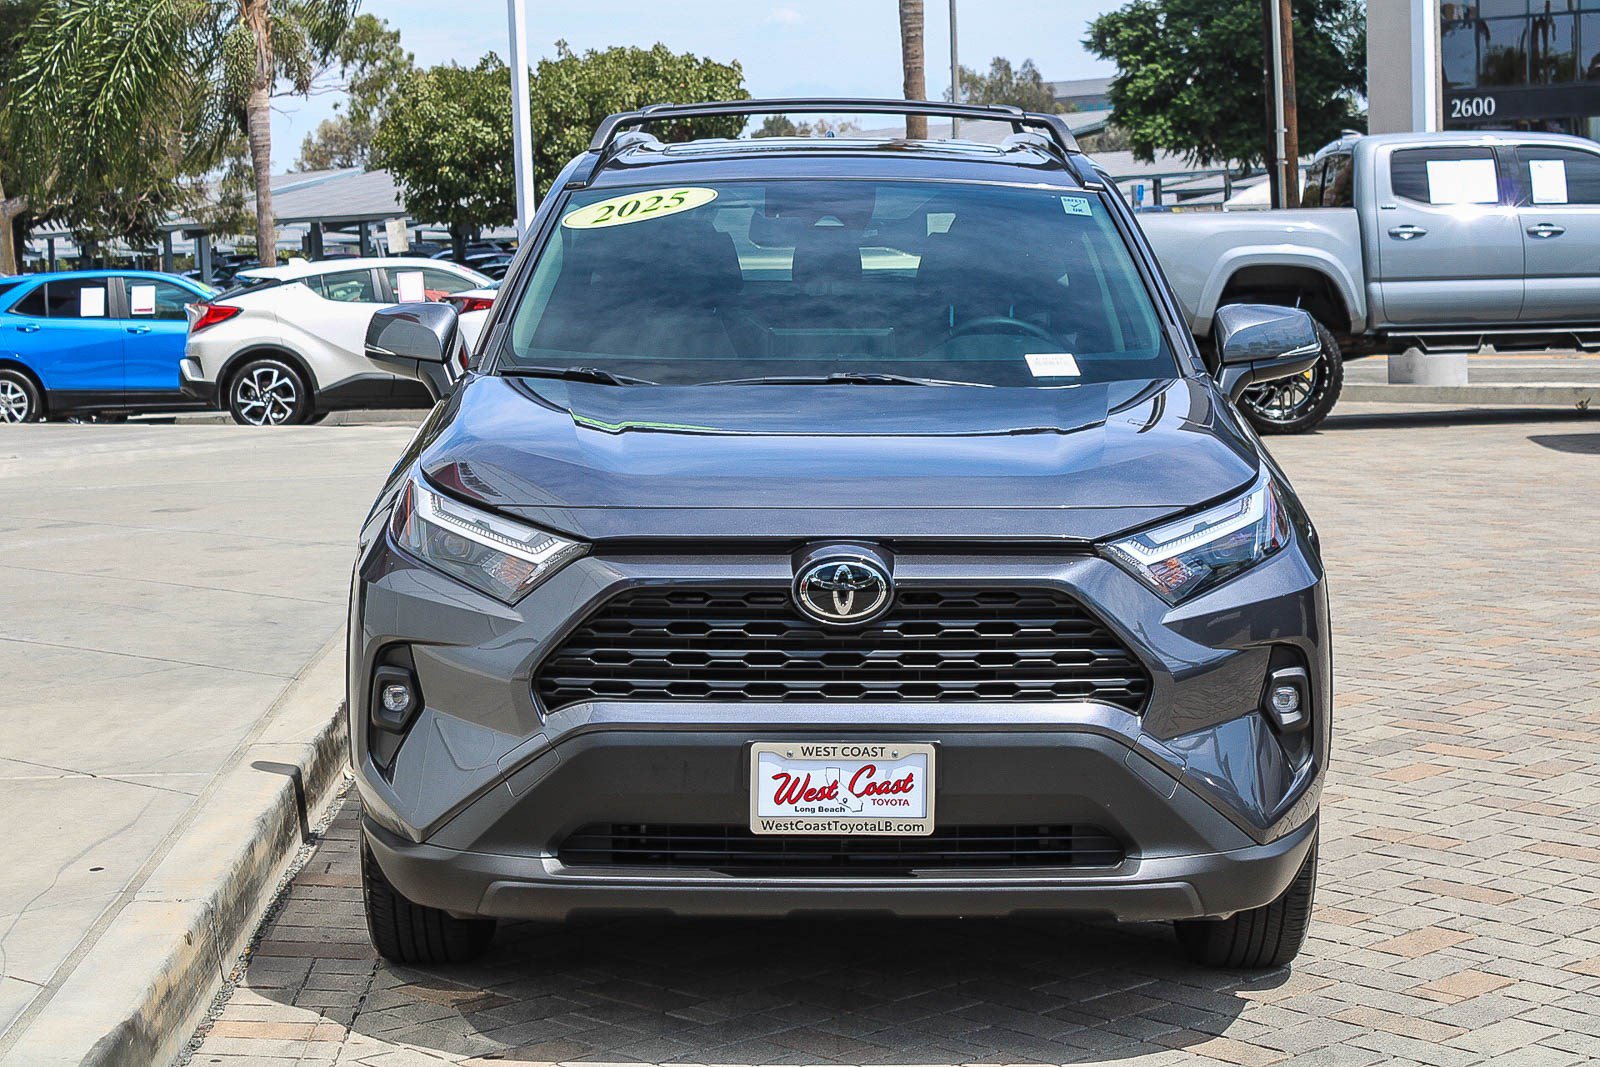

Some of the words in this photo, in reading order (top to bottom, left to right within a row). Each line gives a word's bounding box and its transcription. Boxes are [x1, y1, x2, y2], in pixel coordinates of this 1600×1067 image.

[1451, 96, 1496, 118] 2600
[591, 190, 690, 224] 2025
[801, 746, 838, 757] WEST
[841, 746, 886, 757] COAST
[771, 773, 839, 806] West
[848, 763, 914, 798] Coast
[794, 805, 816, 814] Long
[817, 805, 846, 813] Beach
[871, 798, 910, 807] TOYOTA
[761, 820, 925, 834] WestCoastToyotaLB.com
